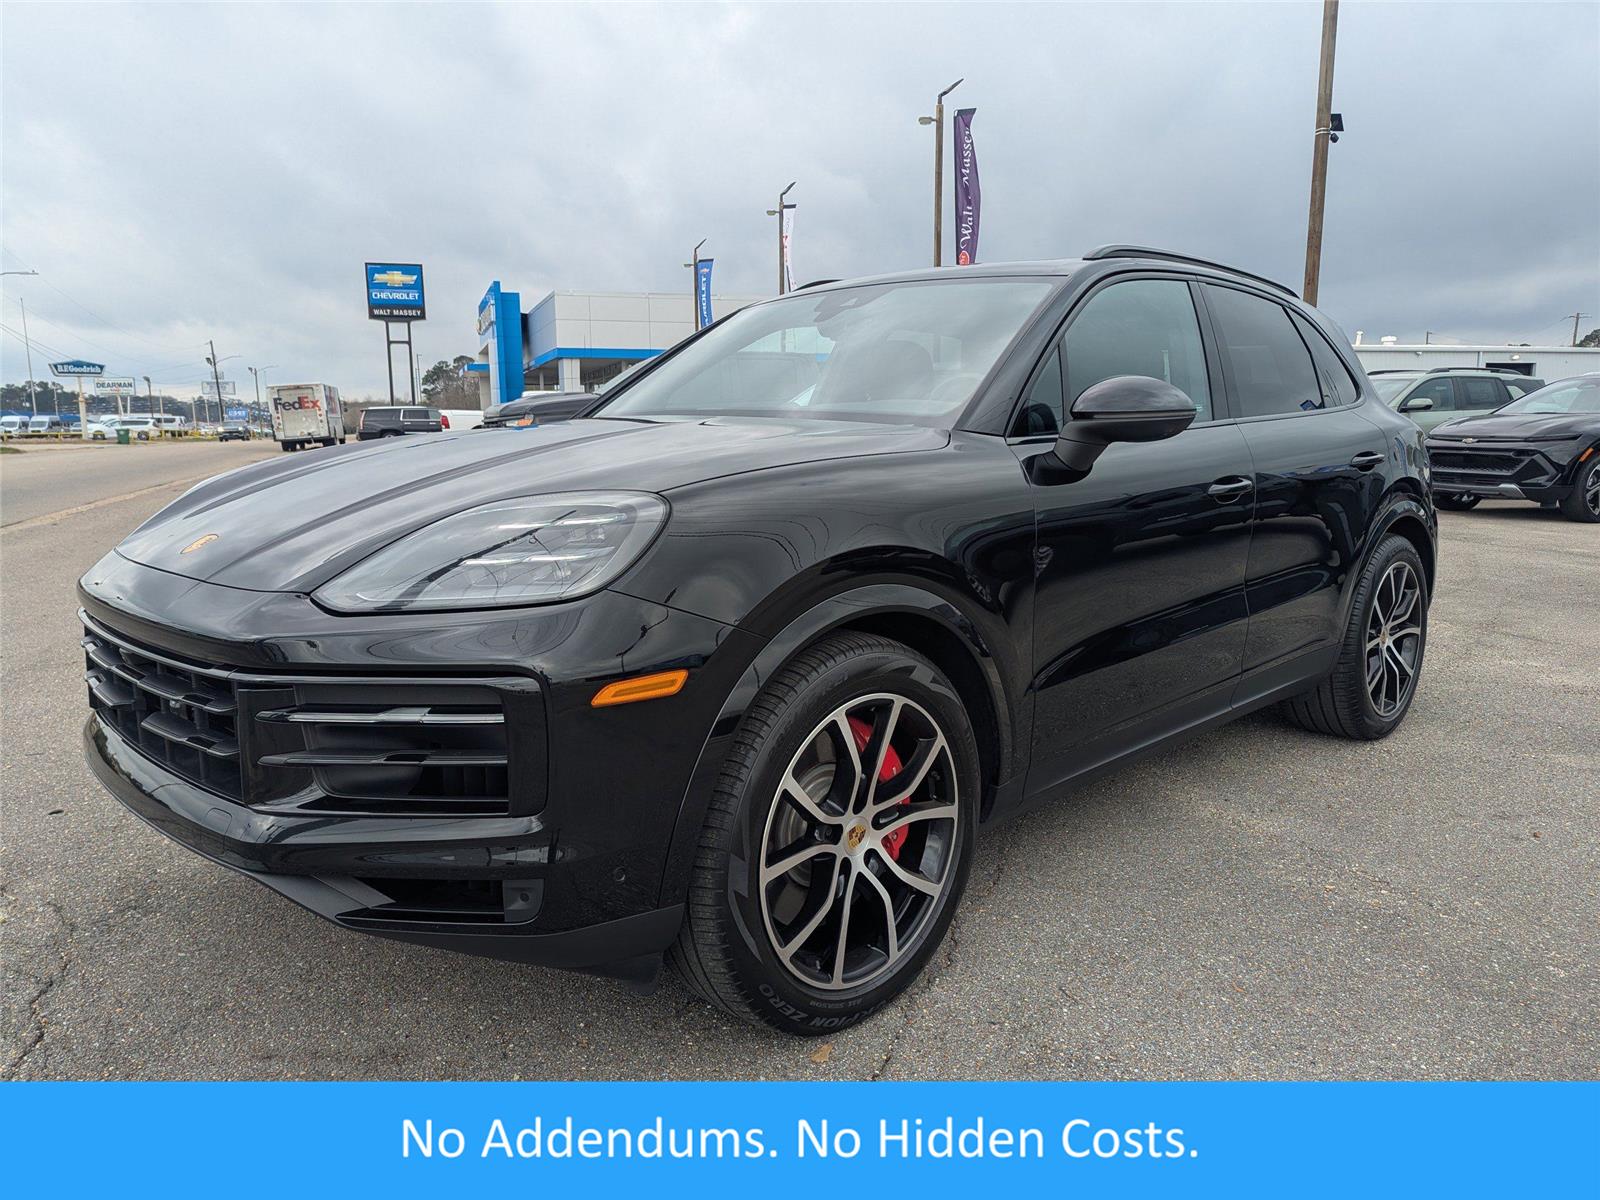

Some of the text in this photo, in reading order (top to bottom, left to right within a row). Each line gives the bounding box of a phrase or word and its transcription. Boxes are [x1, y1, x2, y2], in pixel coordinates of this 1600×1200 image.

[372, 291, 419, 300] CHEVROLET
[373, 308, 391, 316] WALT
[273, 396, 320, 411] FedEx
[759, 983, 808, 1022] ZERO
